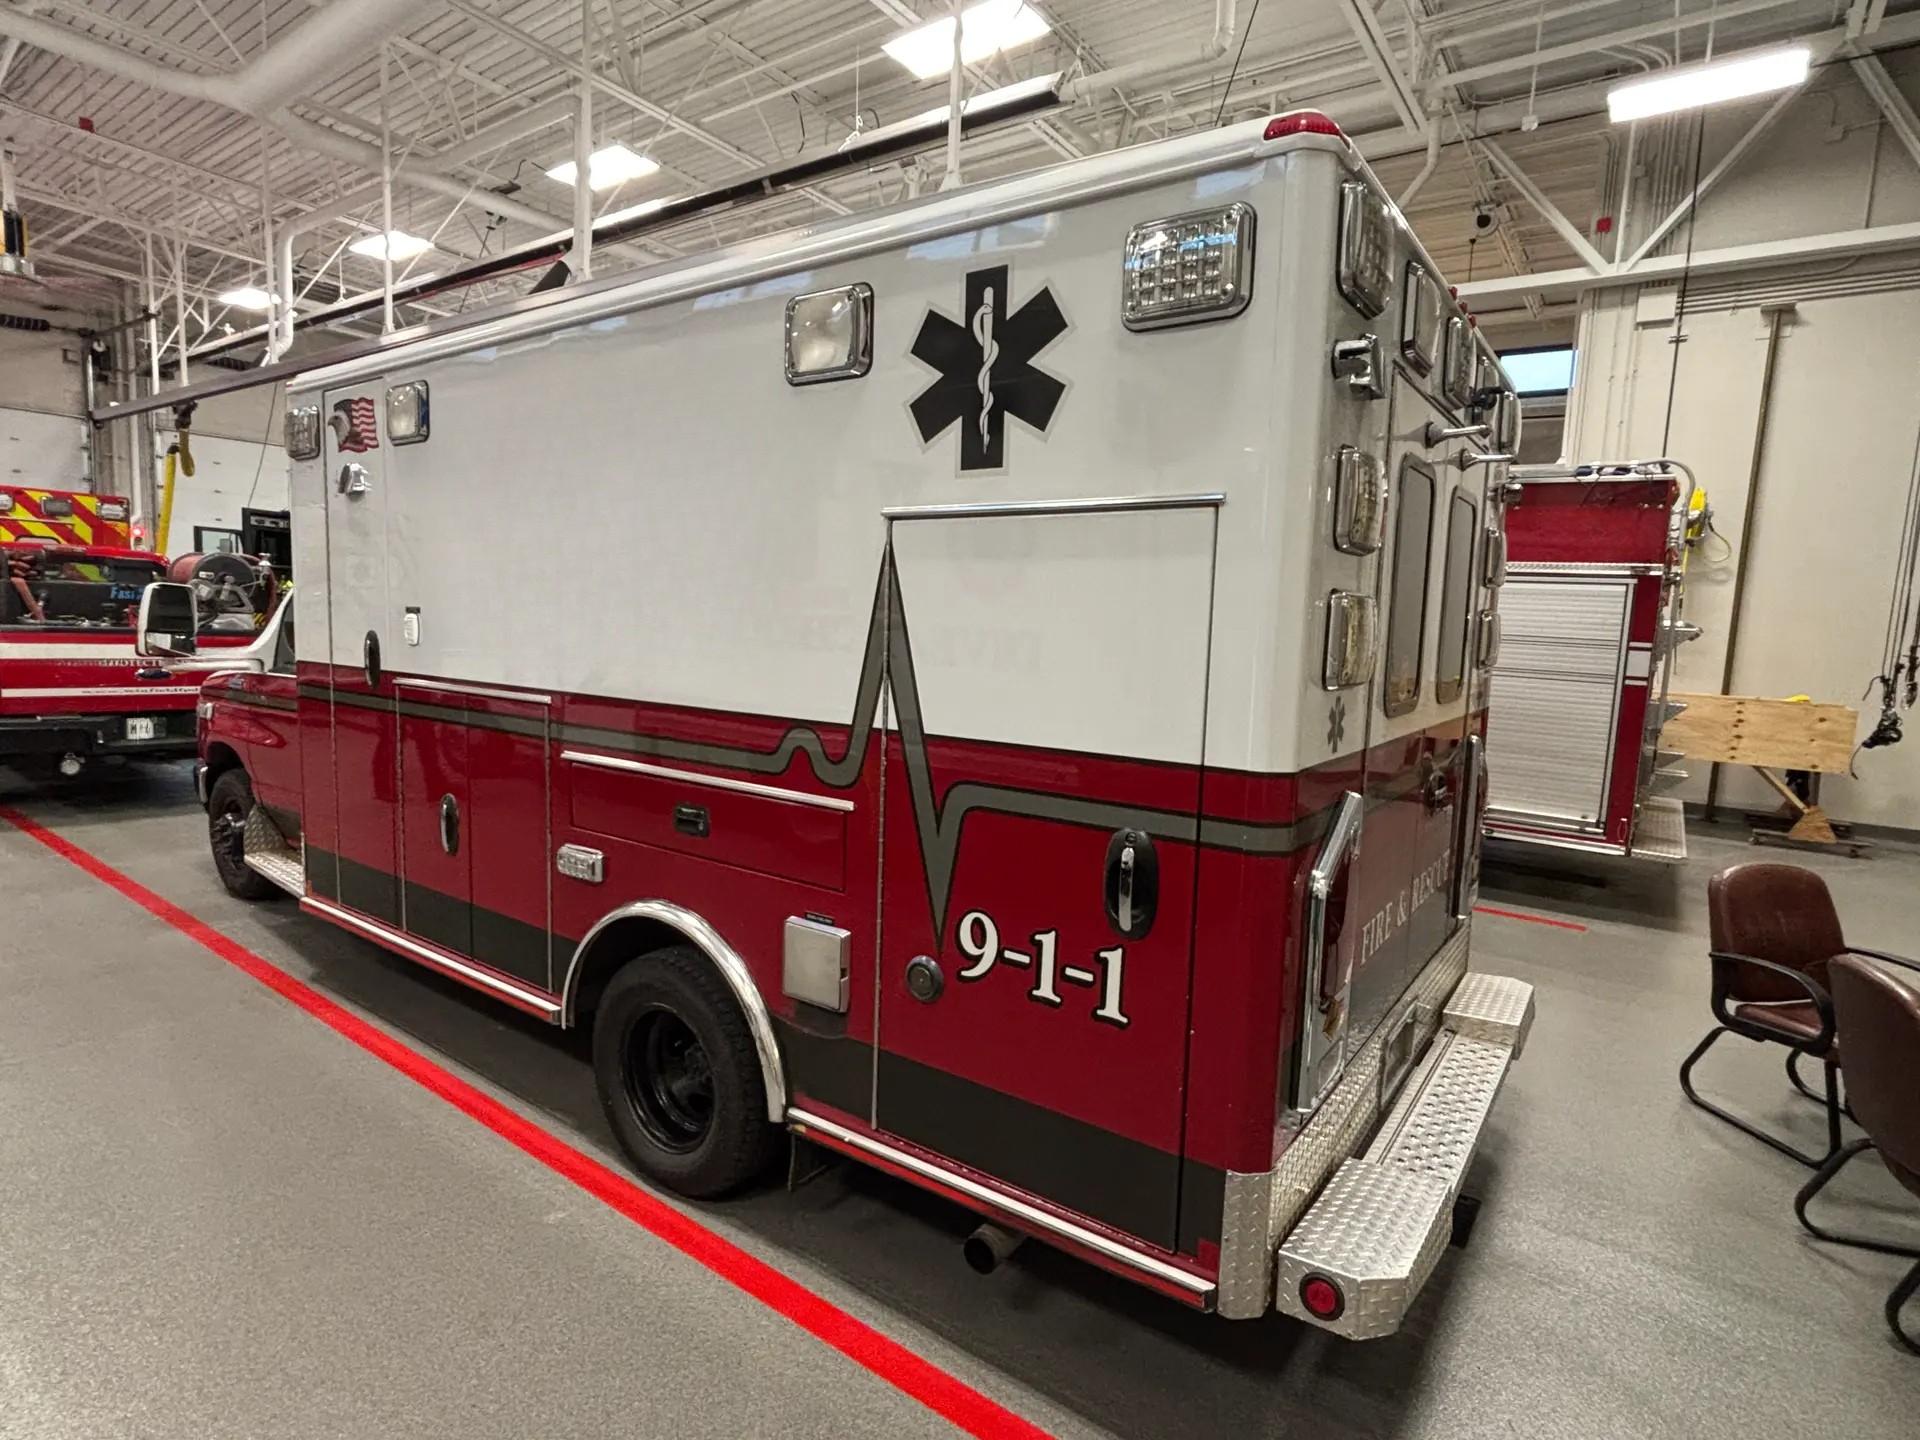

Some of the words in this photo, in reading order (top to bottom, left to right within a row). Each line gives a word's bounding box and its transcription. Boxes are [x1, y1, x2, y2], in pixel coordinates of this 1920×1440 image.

[1361, 902, 1393, 965] FIRE
[1397, 890, 1407, 927] &
[1411, 847, 1451, 913] RESCUE
[957, 910, 1131, 1027] 9-1-1
